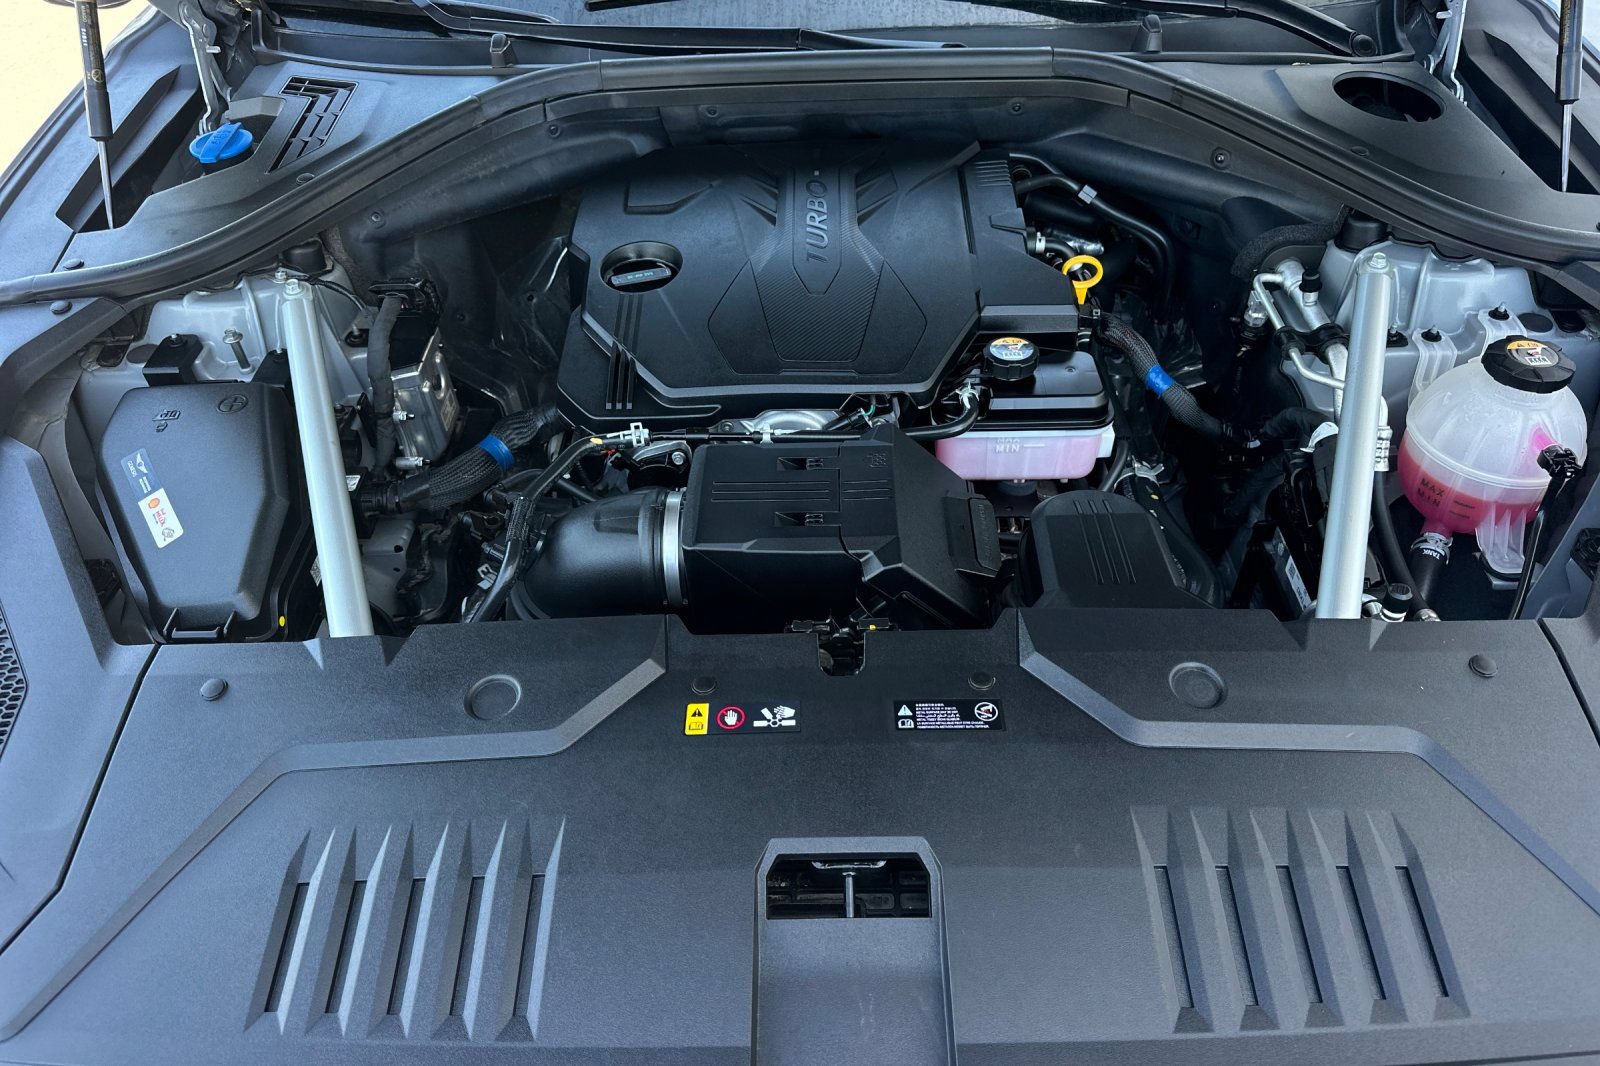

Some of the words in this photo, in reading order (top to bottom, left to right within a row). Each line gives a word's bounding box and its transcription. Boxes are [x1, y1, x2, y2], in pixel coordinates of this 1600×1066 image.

[805, 179, 829, 263] TURBO
[995, 443, 1020, 453] MIN
[1421, 478, 1446, 497] MAX
[1422, 548, 1441, 560] TANK
